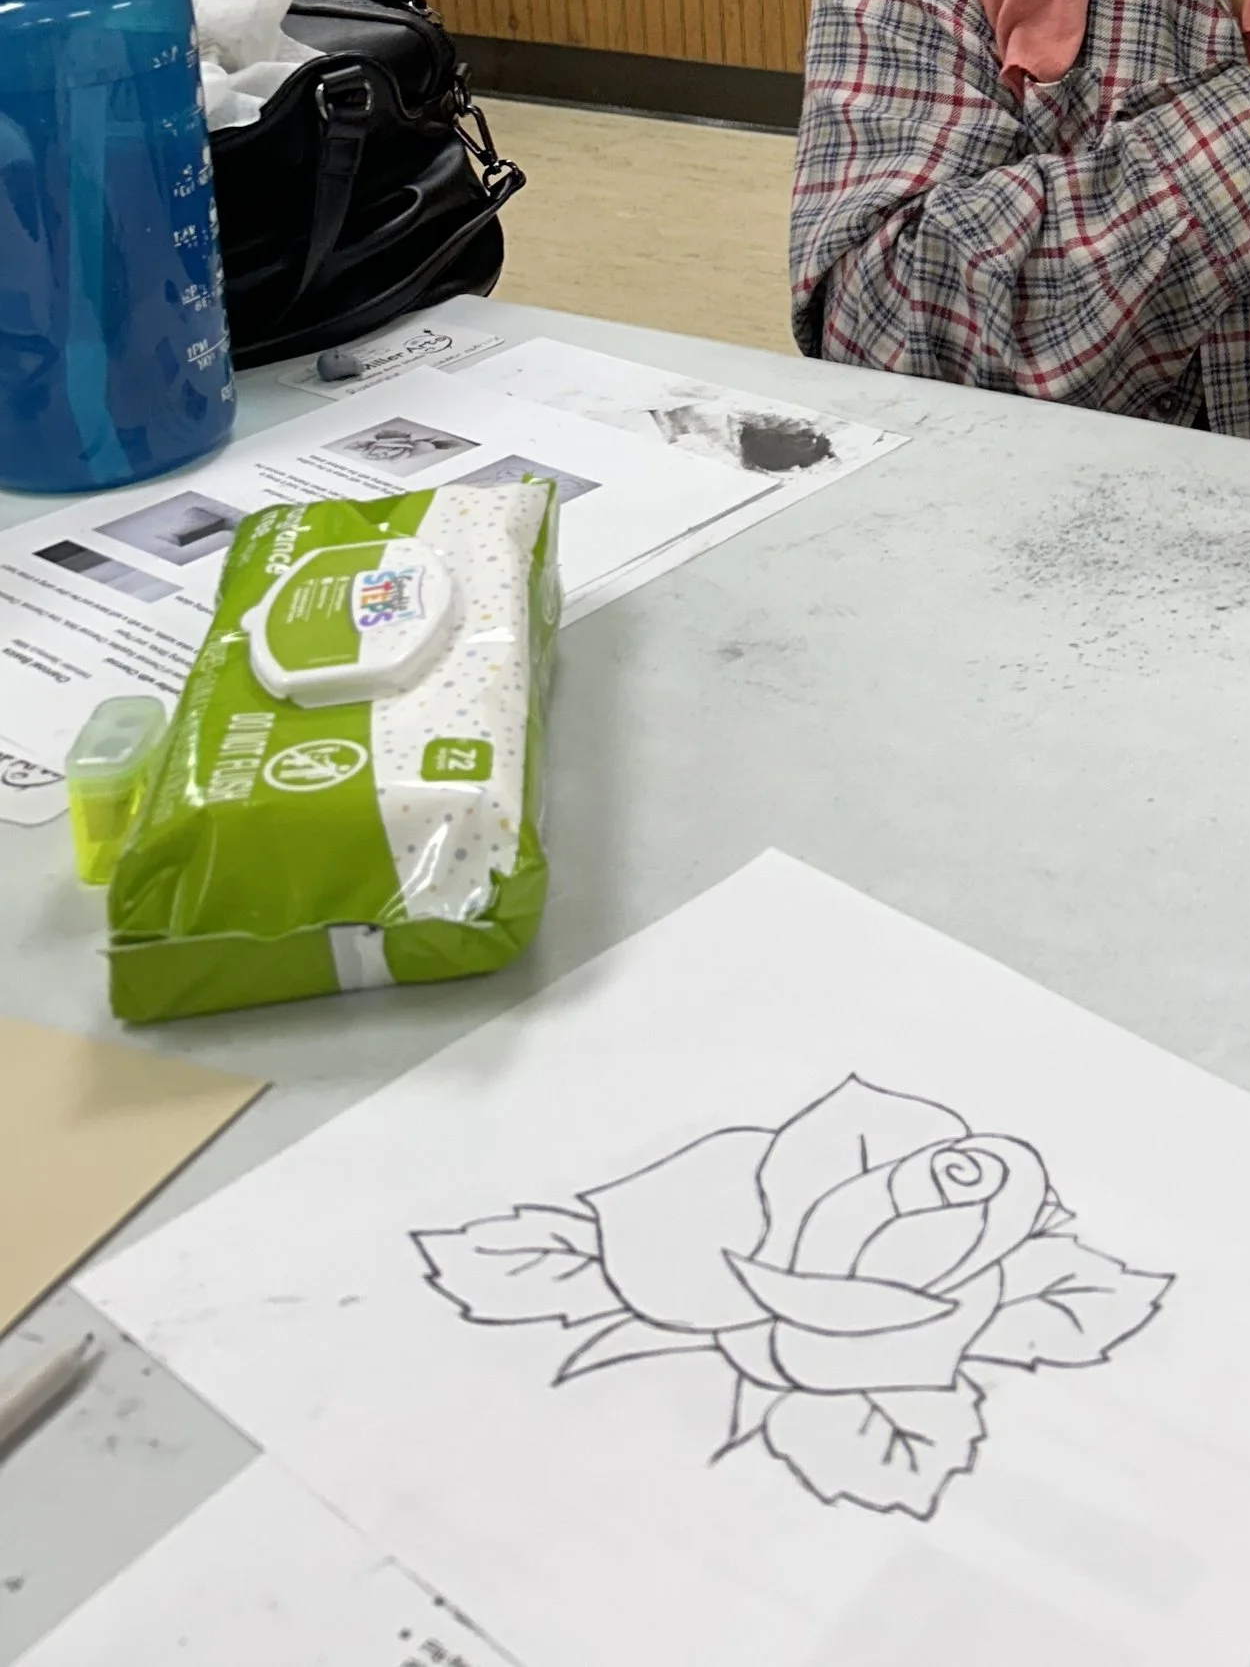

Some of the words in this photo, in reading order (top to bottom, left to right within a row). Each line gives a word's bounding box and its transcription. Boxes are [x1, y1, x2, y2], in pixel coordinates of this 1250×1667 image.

[359, 571, 397, 628] STEPS
[2, 647, 33, 664] Basics
[103, 656, 139, 676] Charcoal
[30, 661, 71, 683] Charcoal
[137, 673, 156, 683] with
[228, 712, 276, 731] DO
[219, 730, 269, 757] NOT
[447, 747, 477, 772] 72
[205, 758, 262, 803] FLUSH
